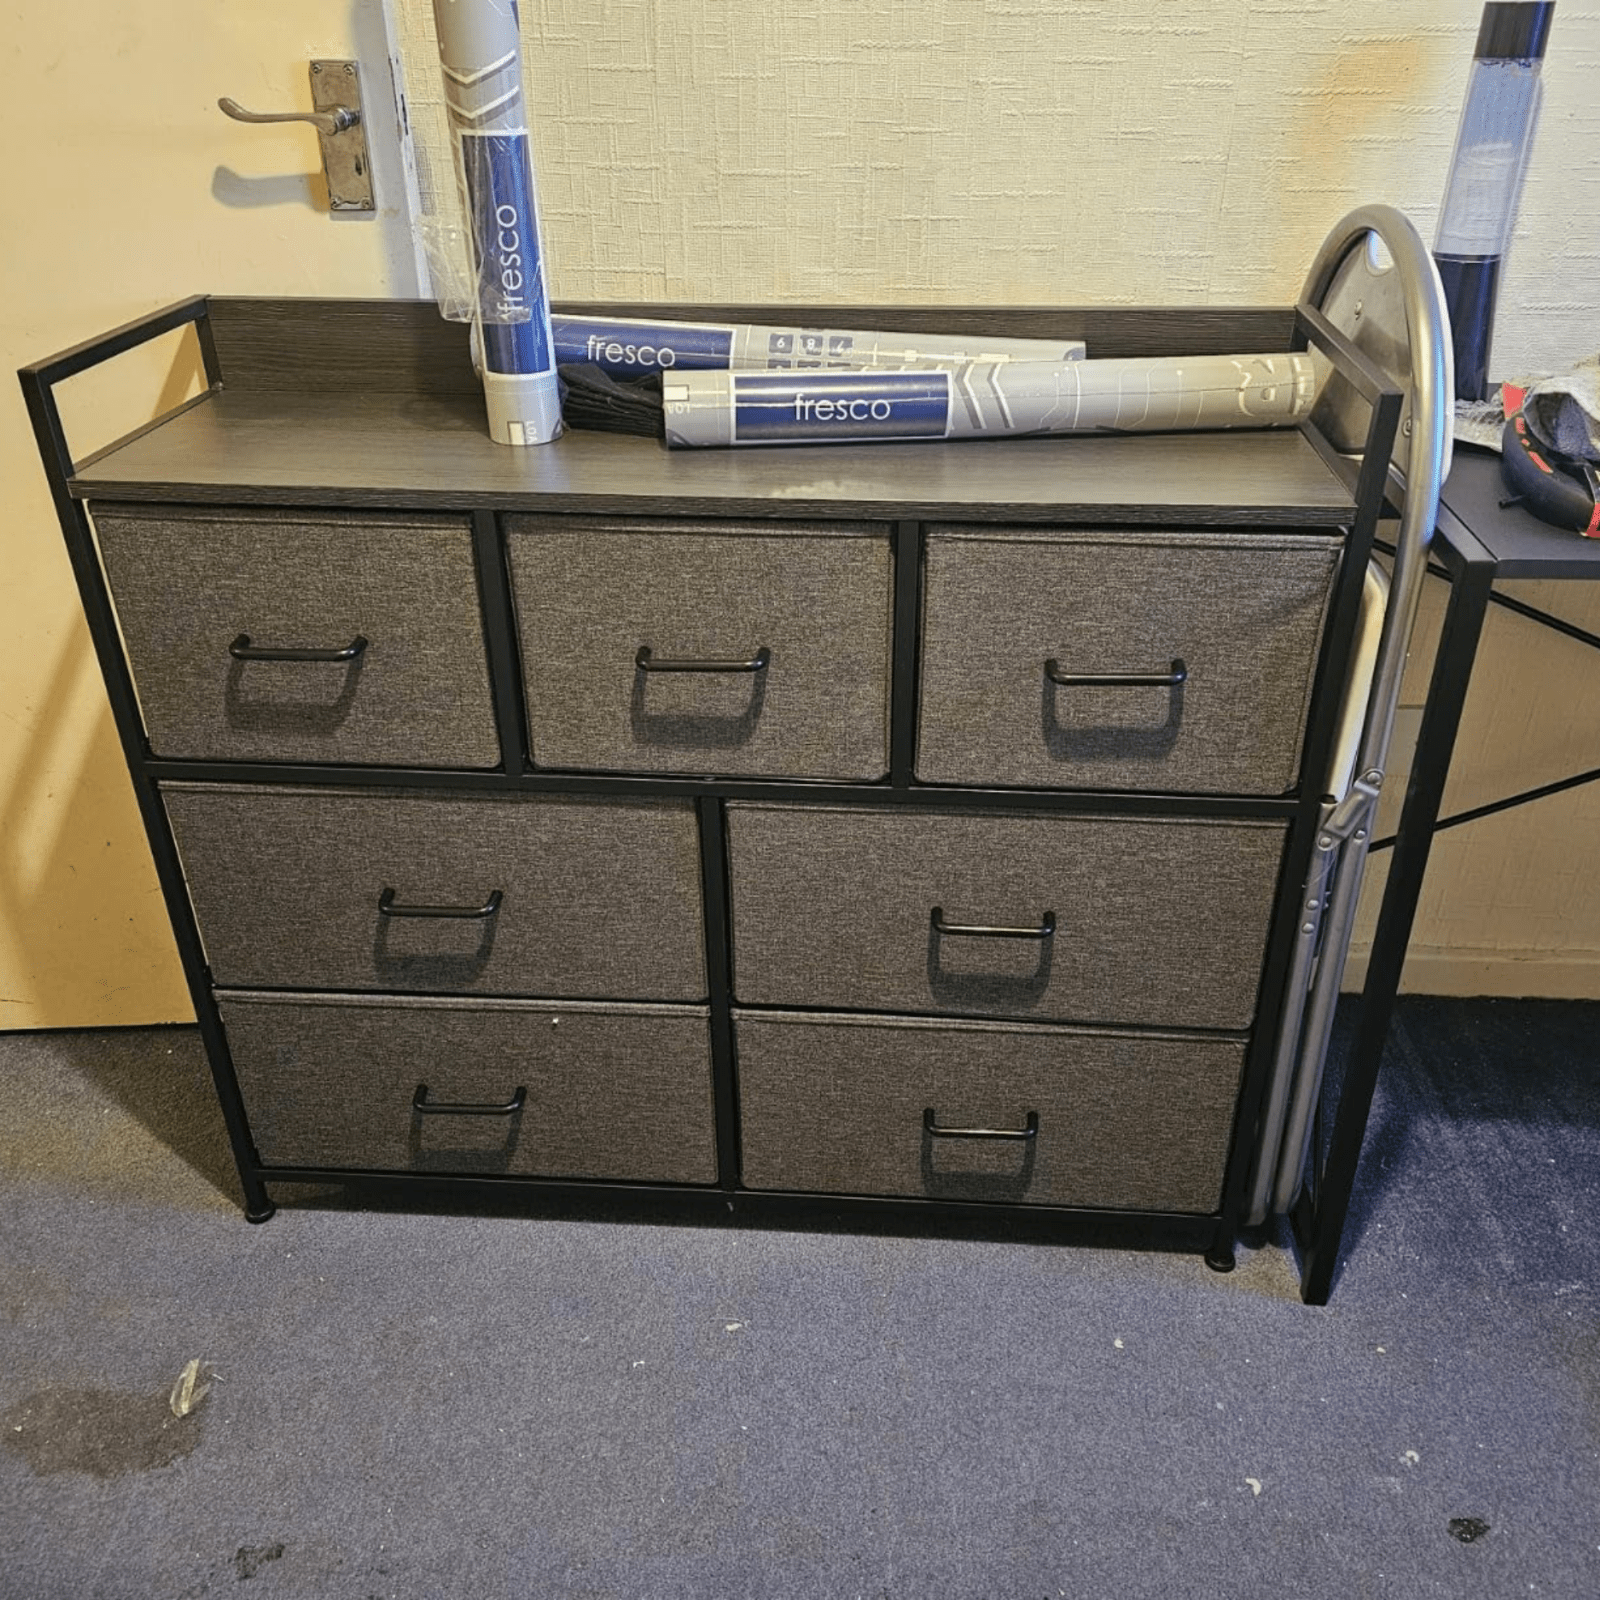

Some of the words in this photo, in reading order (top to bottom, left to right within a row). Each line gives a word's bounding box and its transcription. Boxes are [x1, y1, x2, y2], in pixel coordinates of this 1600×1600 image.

[496, 204, 524, 313] fresco
[587, 334, 676, 367] fresco
[806, 338, 816, 351] 8
[795, 393, 891, 420] fresco
